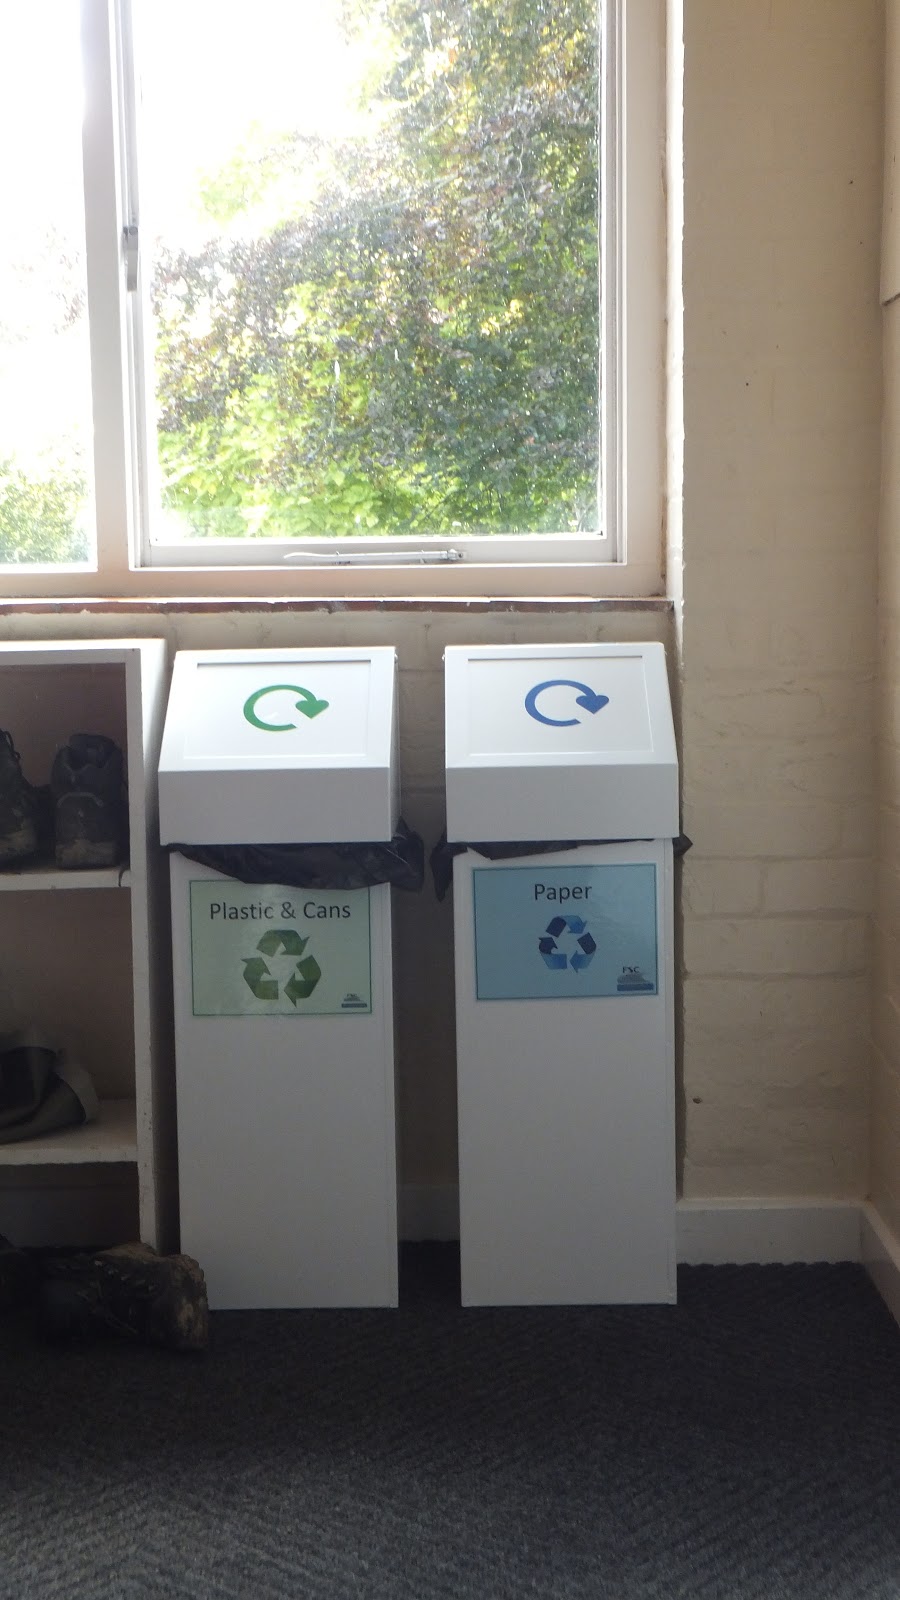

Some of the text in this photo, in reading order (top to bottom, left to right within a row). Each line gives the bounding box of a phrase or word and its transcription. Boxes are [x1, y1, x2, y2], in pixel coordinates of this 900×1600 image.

[534, 883, 593, 904] Paper
[210, 901, 351, 920] Plastic & Cans
